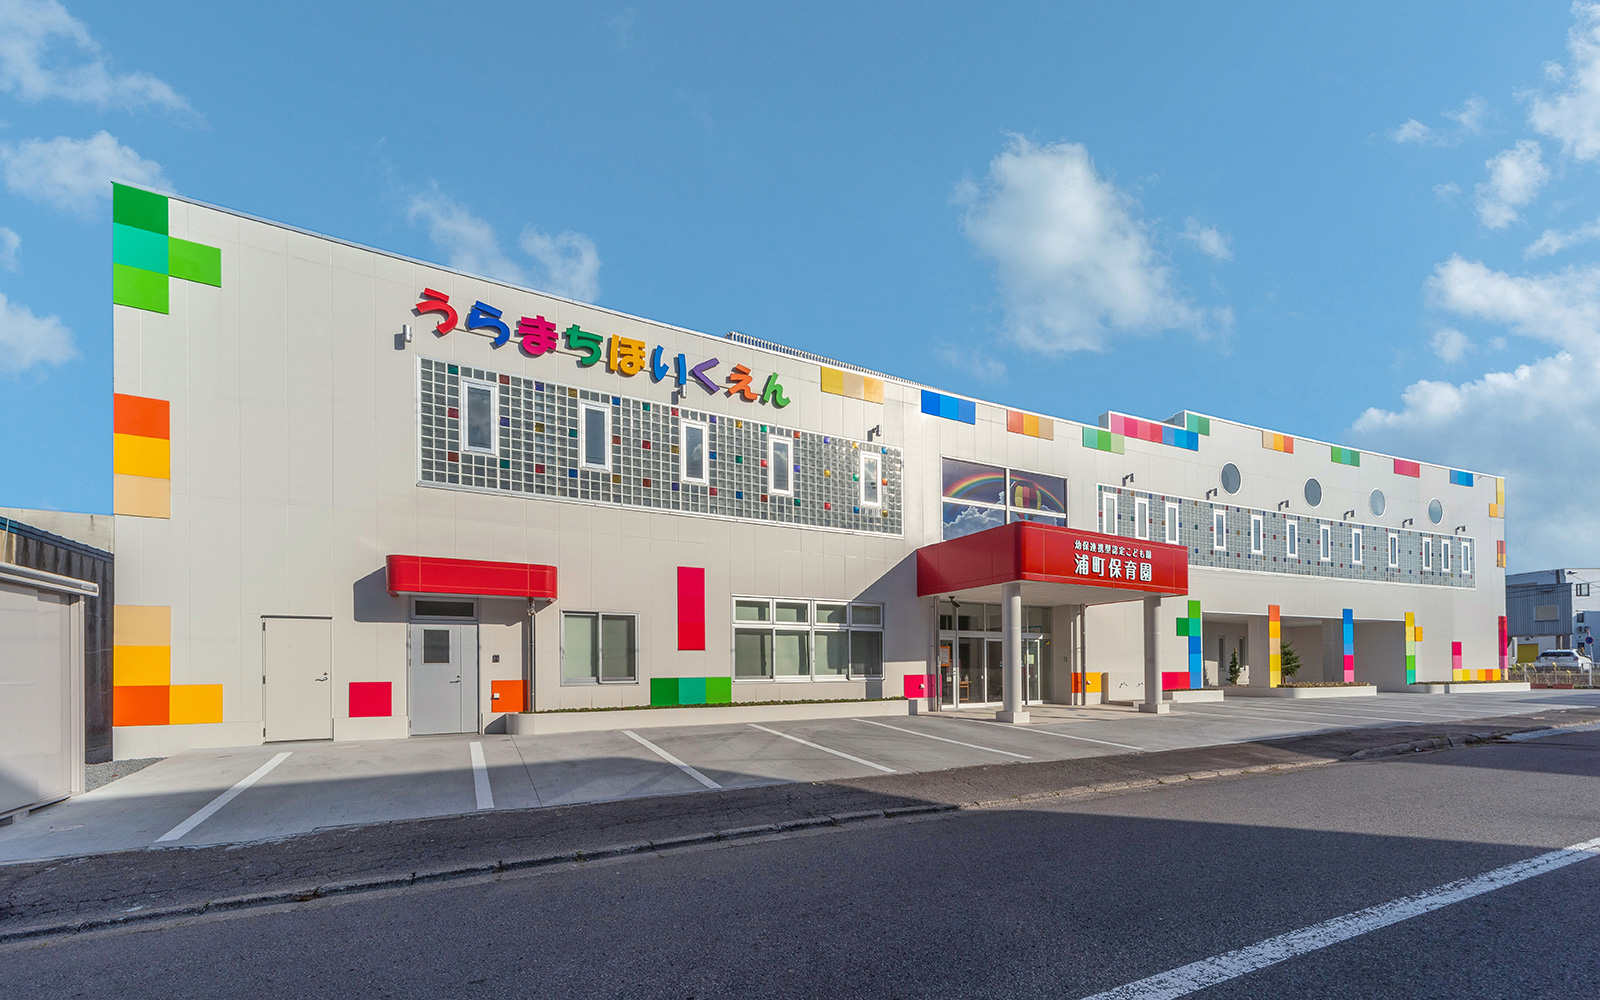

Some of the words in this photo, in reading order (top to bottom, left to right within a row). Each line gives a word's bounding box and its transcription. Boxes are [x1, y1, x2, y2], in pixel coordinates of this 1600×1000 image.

[415, 287, 791, 407] うらまちほいくえん
[1074, 553, 1152, 581] 浦町保育園
